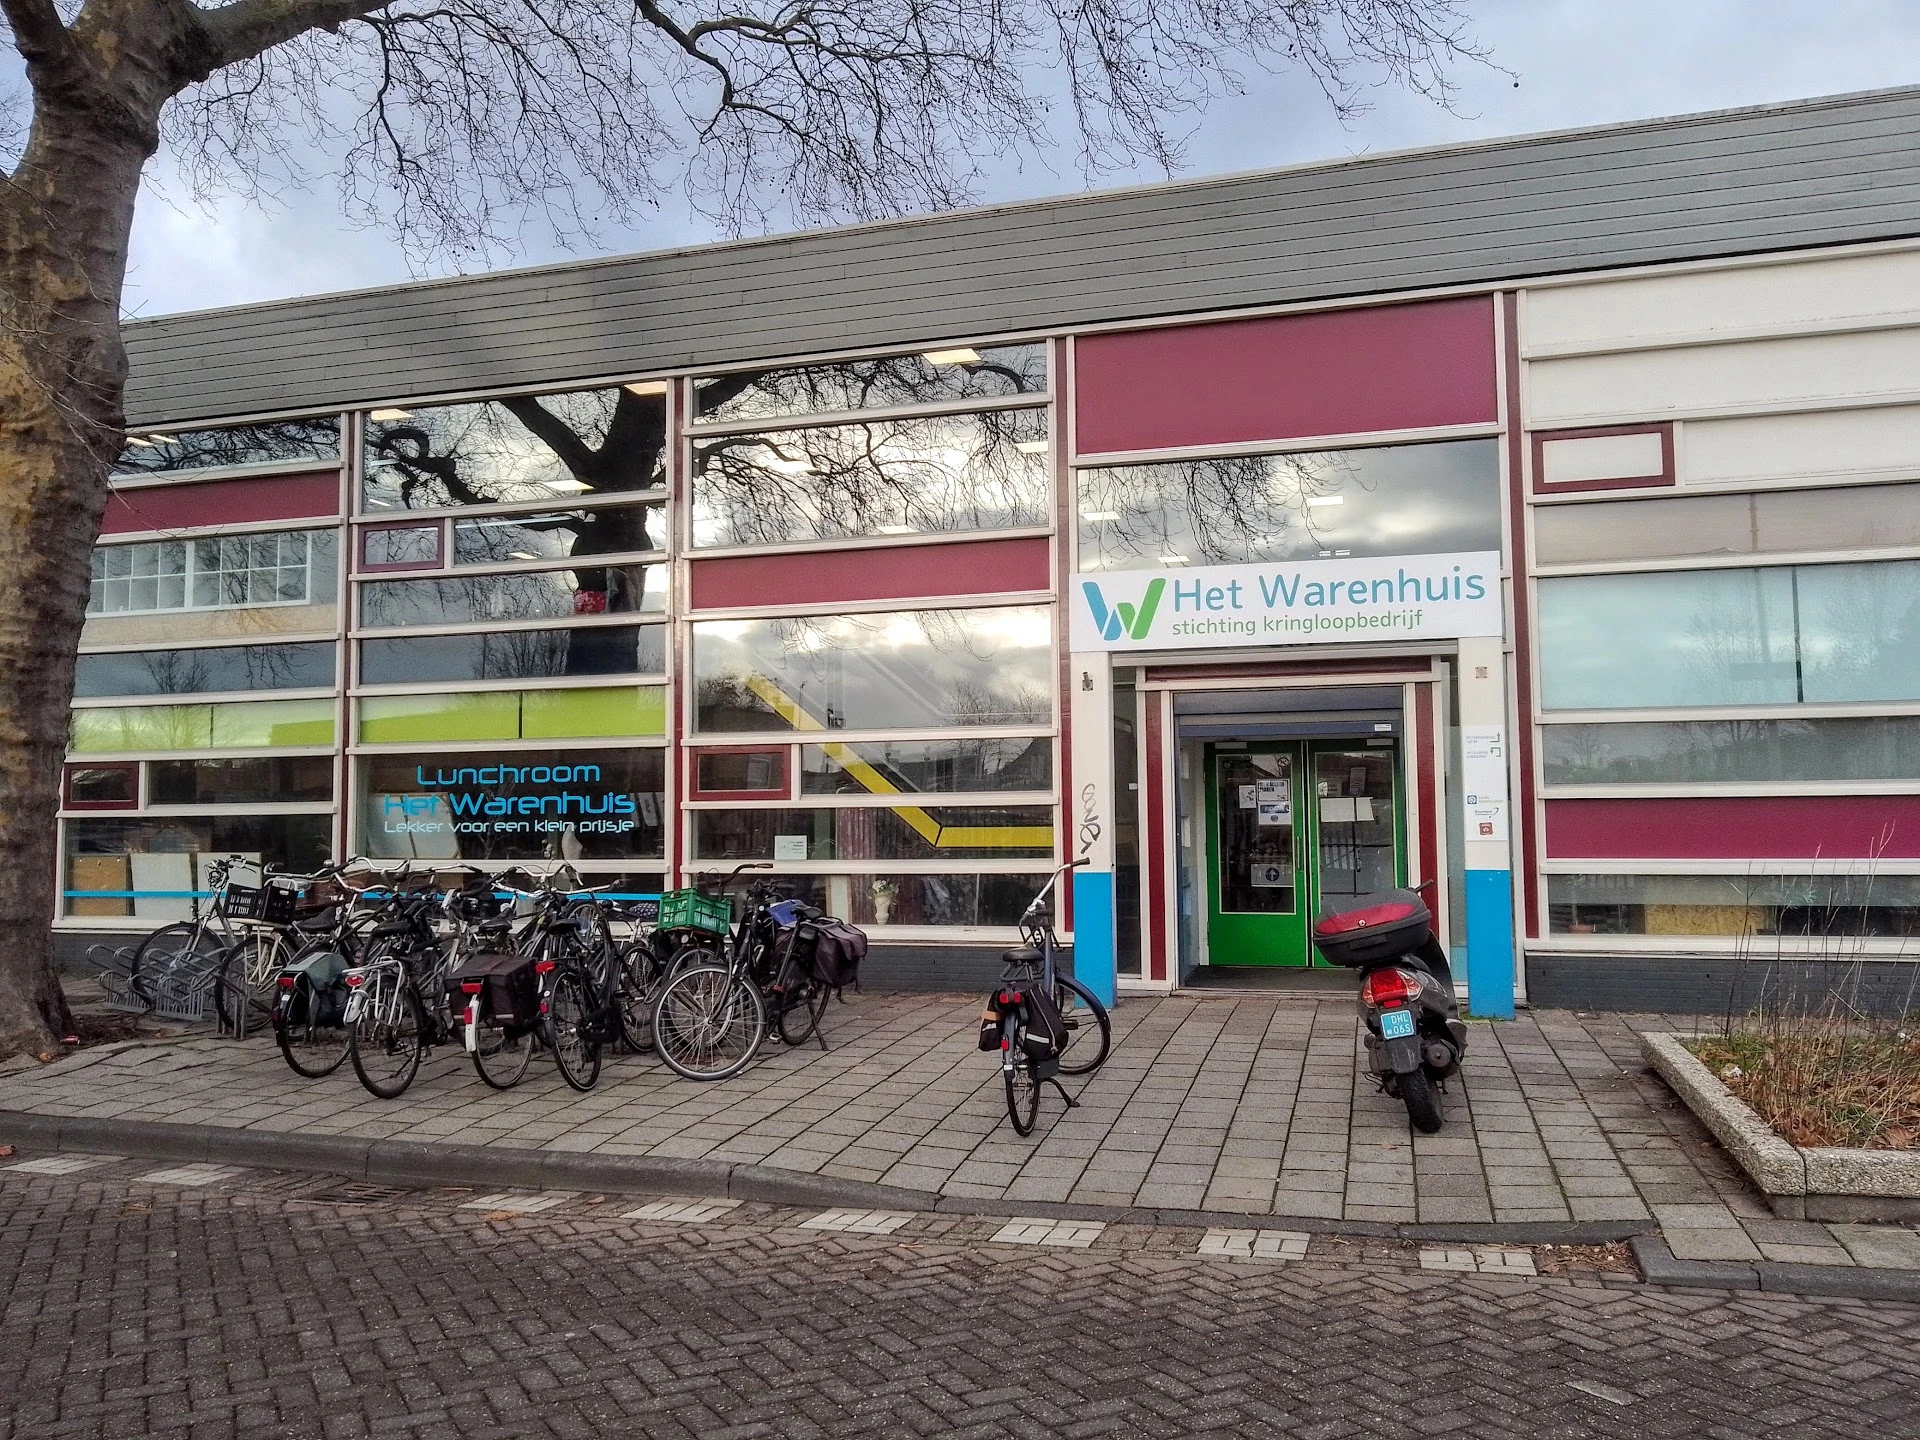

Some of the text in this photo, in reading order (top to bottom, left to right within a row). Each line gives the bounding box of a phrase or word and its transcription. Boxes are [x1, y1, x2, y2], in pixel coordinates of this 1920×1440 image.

[1174, 565, 1486, 611] Het Warenhuis
[1172, 609, 1423, 636] stichting kringloopbedrijf
[416, 764, 600, 785] Lunchroom
[384, 791, 636, 816] Het Warenhuis
[384, 819, 635, 834] Lekker voor een klein prijsje
[1391, 1014, 1408, 1024] DHL
